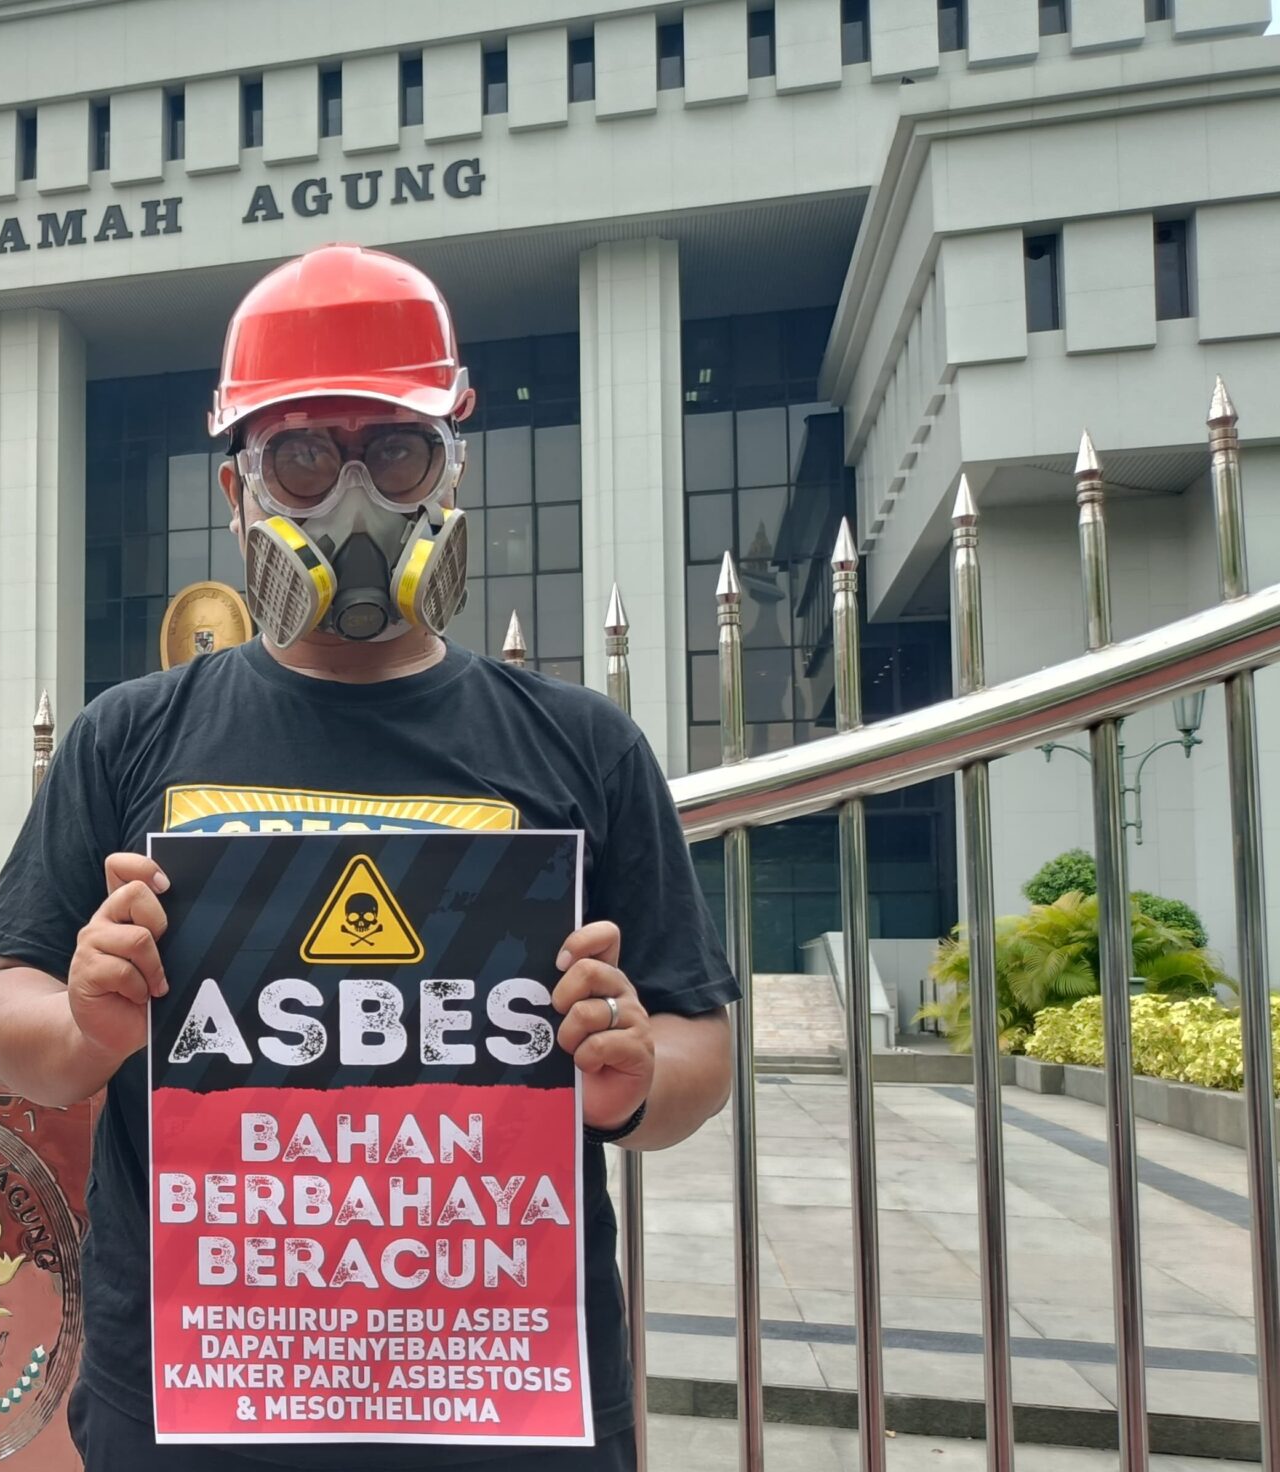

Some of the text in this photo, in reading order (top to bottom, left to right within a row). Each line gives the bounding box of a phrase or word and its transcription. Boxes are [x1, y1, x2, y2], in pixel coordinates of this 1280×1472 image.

[241, 157, 486, 224] AGUNG
[167, 977, 554, 1066] ASBES
[240, 1112, 483, 1164] BAHAN
[158, 1173, 571, 1227] BERBAHAYA
[198, 1236, 528, 1289] BERACUN
[181, 1305, 549, 1333] MENGHIRUP DEBU ASBES
[201, 1335, 530, 1362] DAPAT MENYEBABKAN
[163, 1364, 572, 1394] KANKER PARU, ASBESTOSIS
[236, 1396, 500, 1423] & MESOTHELIOMA
